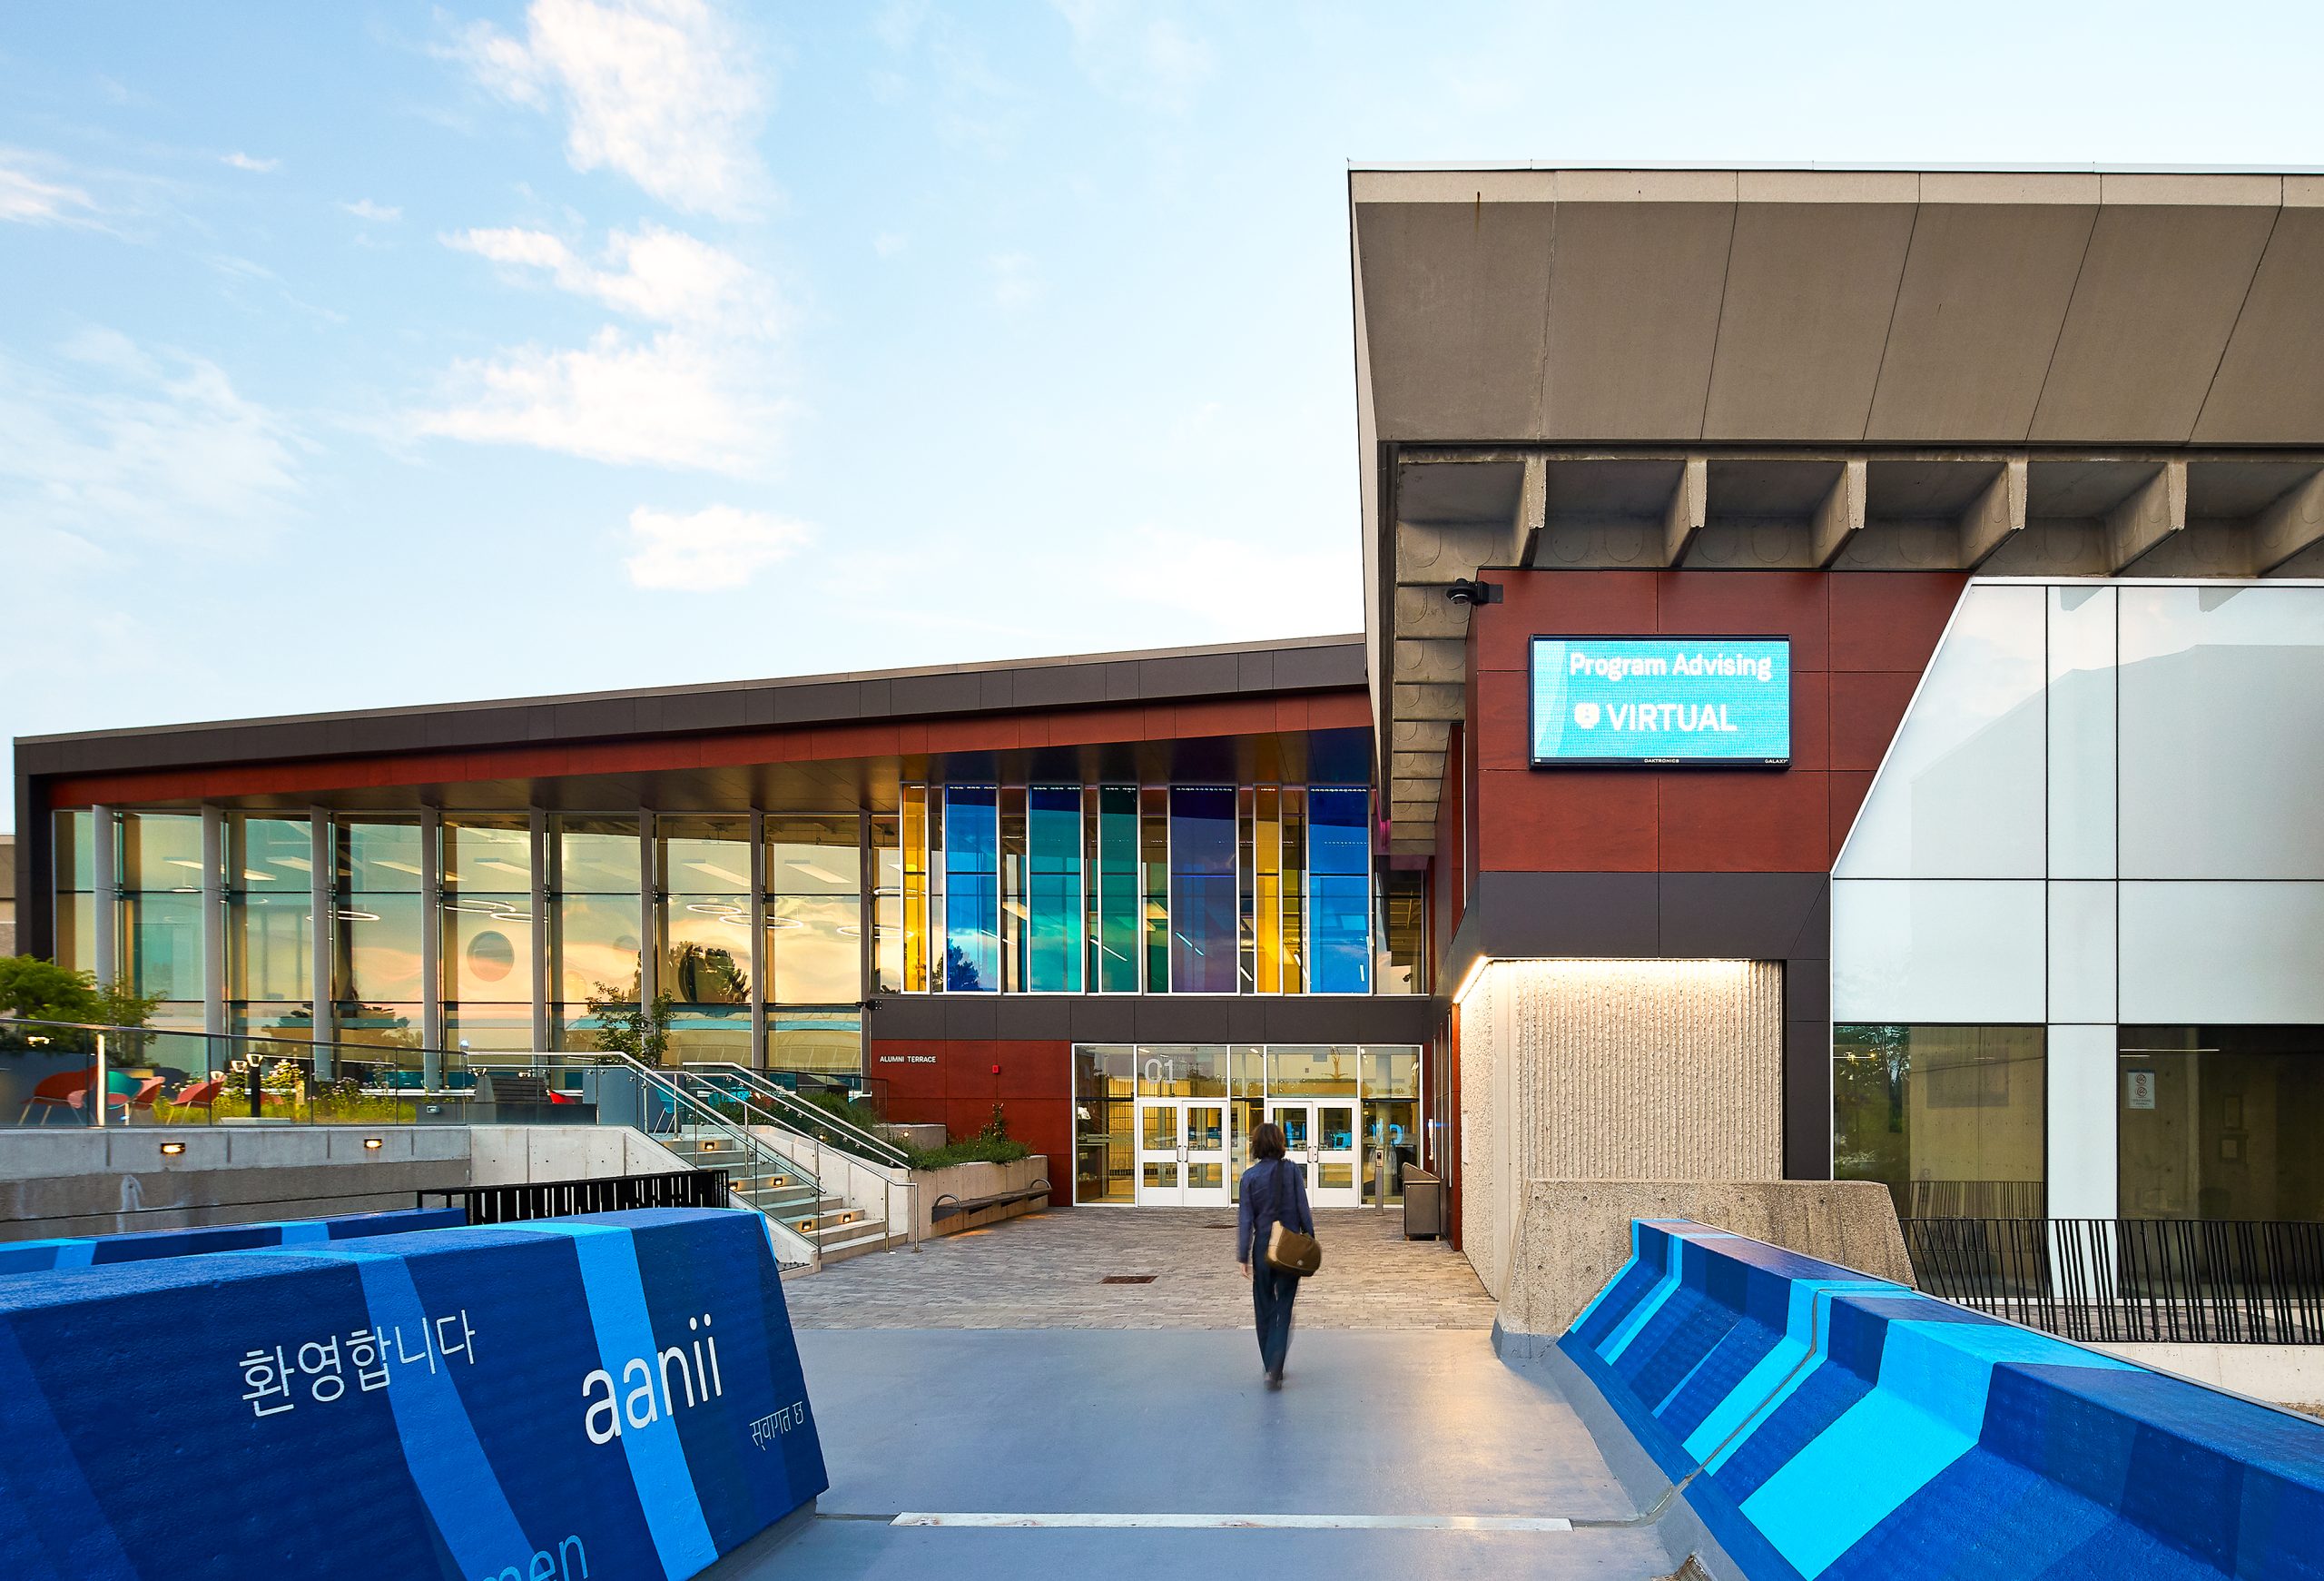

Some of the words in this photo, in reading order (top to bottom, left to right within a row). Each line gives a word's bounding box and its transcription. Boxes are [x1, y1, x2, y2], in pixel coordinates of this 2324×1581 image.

[1571, 653, 1667, 681] Program
[1672, 653, 1772, 681] Advising
[1606, 704, 1738, 731] VIRTUAL
[907, 1055, 937, 1063] TERRACE
[239, 1309, 476, 1418] 환영합니다
[582, 1313, 723, 1445] aanii
